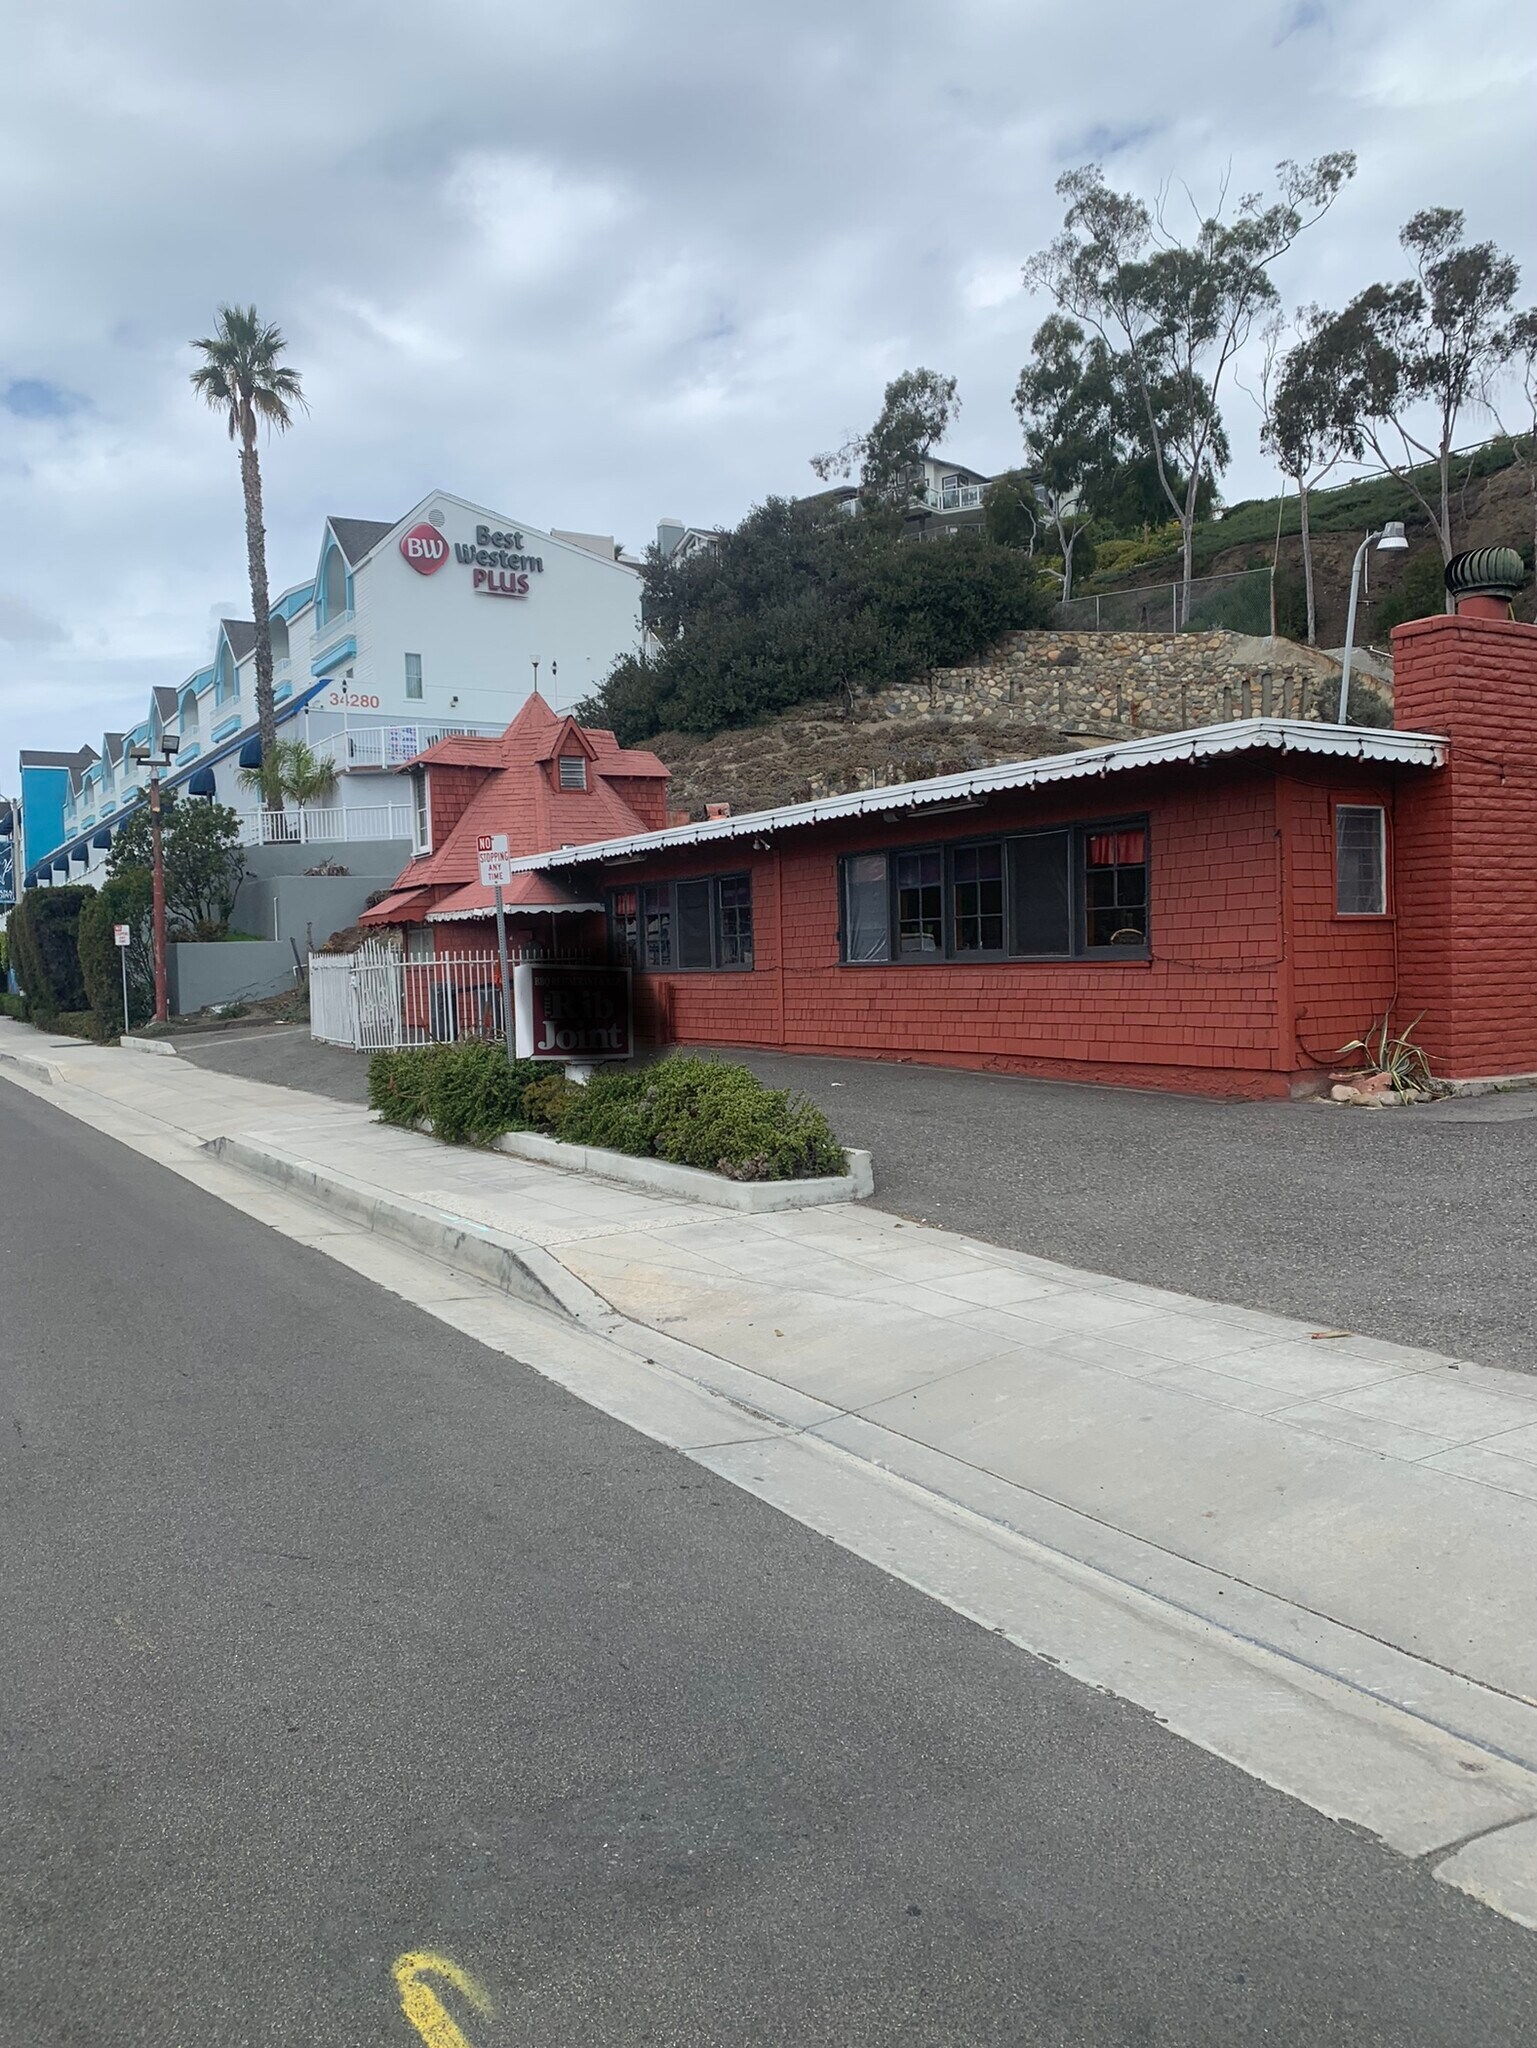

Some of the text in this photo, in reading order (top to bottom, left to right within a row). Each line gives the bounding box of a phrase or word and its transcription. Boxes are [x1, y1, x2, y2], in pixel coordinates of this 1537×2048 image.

[407, 537, 443, 559] BW
[476, 524, 524, 550] Best
[454, 543, 544, 573] Western
[473, 568, 530, 594] PLUS
[329, 692, 380, 708] 34280
[479, 837, 491, 850] NO
[480, 851, 508, 863] STOPPING
[489, 864, 501, 872] ANY
[488, 872, 503, 881] TIME
[550, 990, 615, 1019] Rib
[537, 1020, 623, 1051] Joint
